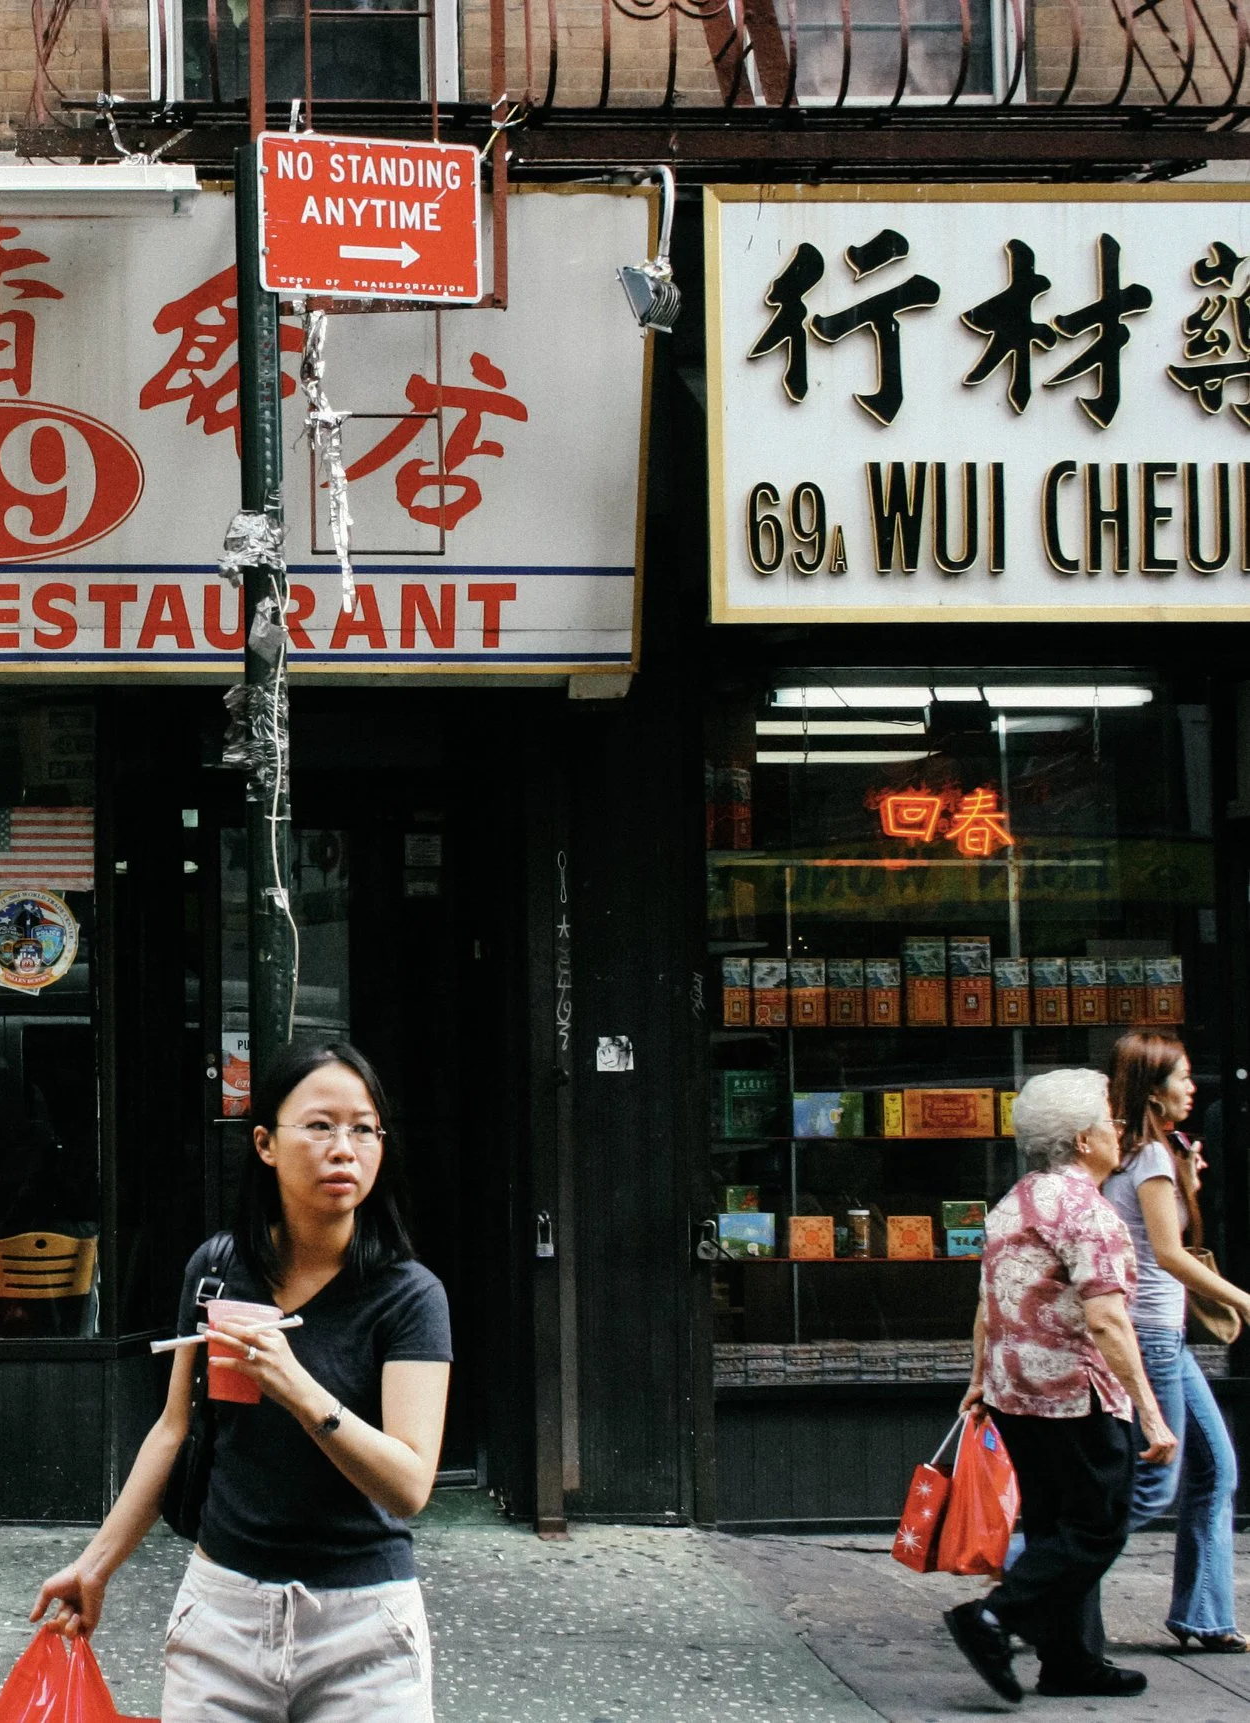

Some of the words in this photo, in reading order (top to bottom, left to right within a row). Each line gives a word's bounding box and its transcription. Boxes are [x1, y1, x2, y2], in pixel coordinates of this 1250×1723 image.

[277, 150, 314, 181] NO
[329, 154, 461, 190] STANDING
[300, 195, 442, 232] ANYTIME
[280, 277, 311, 285] DEPT
[325, 279, 340, 287] OF
[354, 280, 464, 293] TRANSPORTATION
[746, 480, 848, 575] 69A
[865, 461, 1006, 573] WUI
[1041, 460, 1250, 574] CHEU
[882, 786, 1015, 856] 回春
